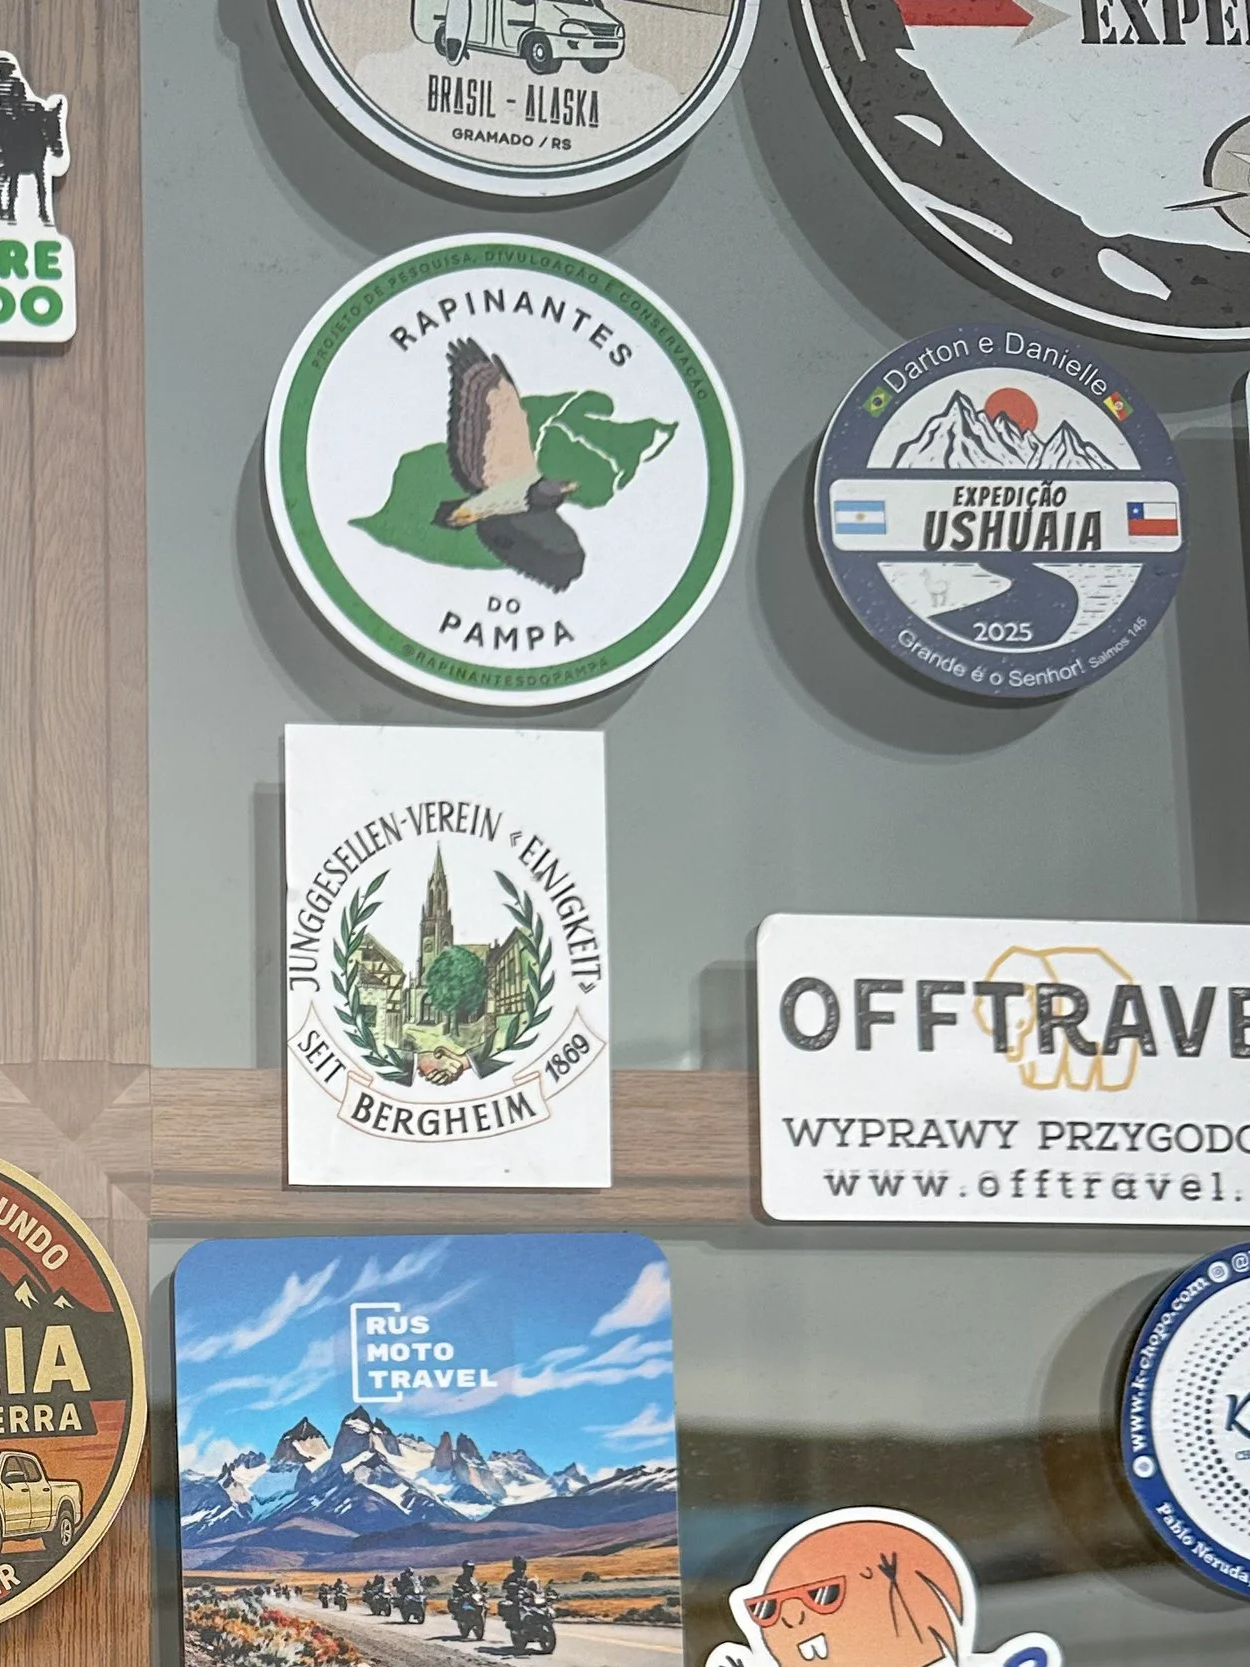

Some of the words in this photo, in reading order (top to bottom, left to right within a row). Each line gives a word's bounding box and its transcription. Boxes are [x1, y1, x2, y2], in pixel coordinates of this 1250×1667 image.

[1082, 0, 1250, 45] EXPE
[427, 74, 496, 119] BRASIL
[525, 83, 599, 129] ALASKA
[451, 128, 534, 148] GRAMADO
[550, 137, 572, 151] RS
[389, 288, 634, 368] RAPINANTES
[883, 337, 969, 394] Darton
[978, 338, 994, 354] e
[1005, 332, 1109, 397] Danielle
[952, 480, 1067, 512] EXPEDIÇÃO
[923, 510, 1101, 551] USHUAIA
[487, 595, 521, 615] DO
[439, 609, 576, 652] PAMPA
[972, 621, 1034, 643] 2025
[897, 629, 965, 677] Grande
[989, 670, 1004, 686] o
[1008, 659, 1086, 688] Senhor!
[1088, 637, 1130, 669] Salmos
[289, 800, 503, 992] JUNGGESELLEN-VEREIN
[297, 1027, 347, 1085] SEIT
[350, 1091, 537, 1138] BERGHEIM
[544, 1032, 591, 1084] 1869
[783, 1117, 1019, 1151] WYPRAWY
[366, 1314, 431, 1337] RUS
[366, 1341, 455, 1363] MOTO
[367, 1367, 499, 1390] TRAVEL
[1156, 1502, 1196, 1546] Pablo
